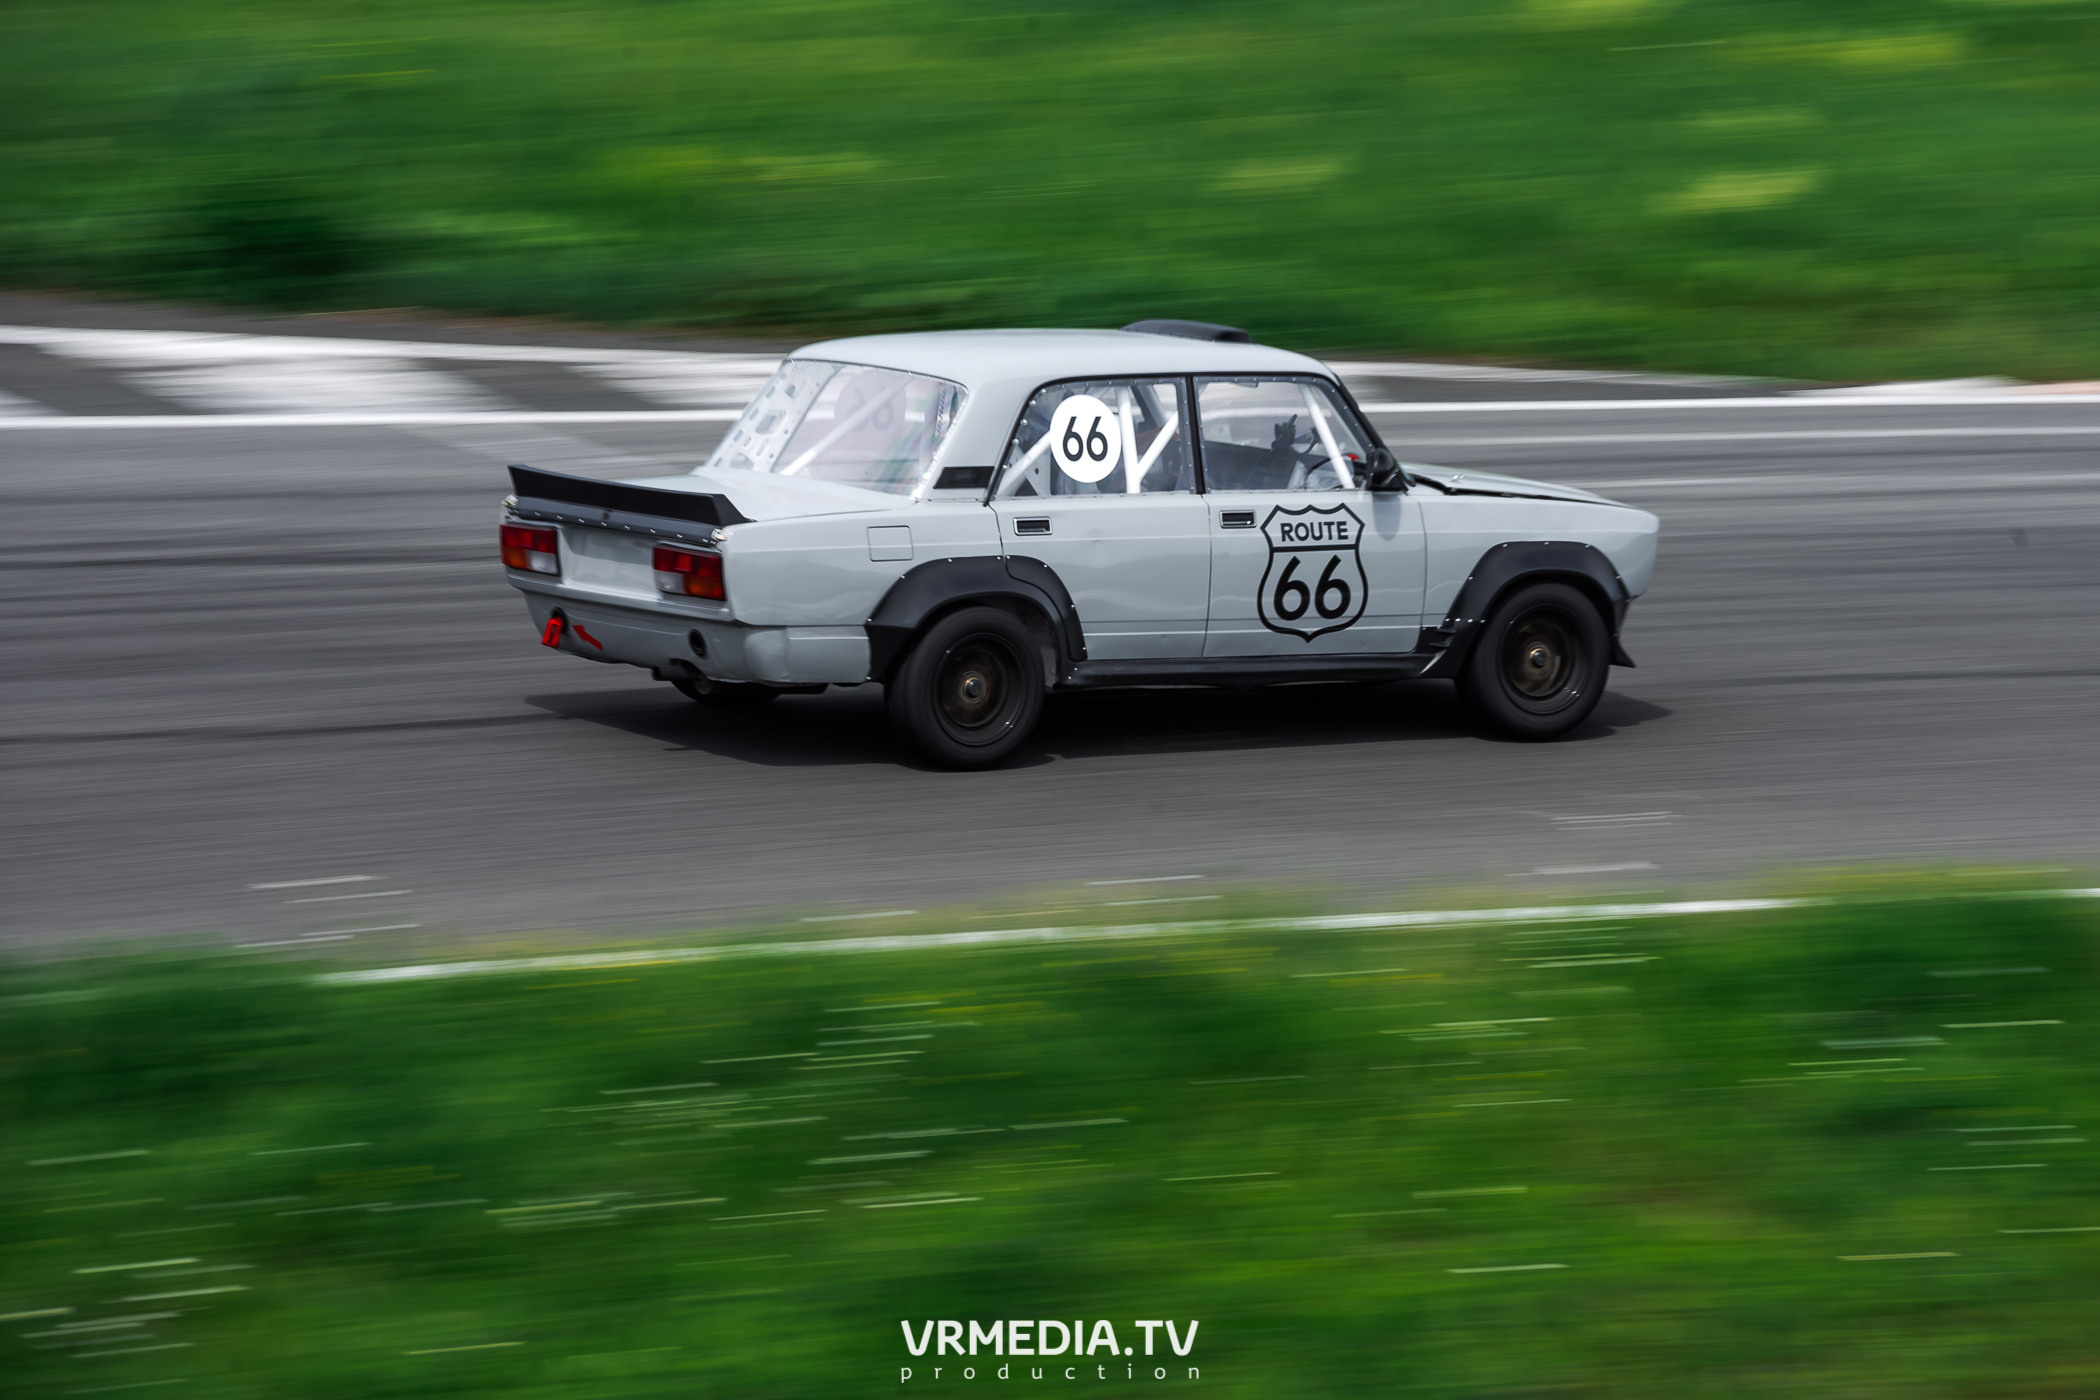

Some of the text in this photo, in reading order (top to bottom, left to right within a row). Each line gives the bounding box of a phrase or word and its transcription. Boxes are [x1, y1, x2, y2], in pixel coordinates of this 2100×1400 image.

[1063, 416, 1108, 462] 66
[1280, 521, 1349, 543] ROUTE
[1275, 555, 1351, 620] 66
